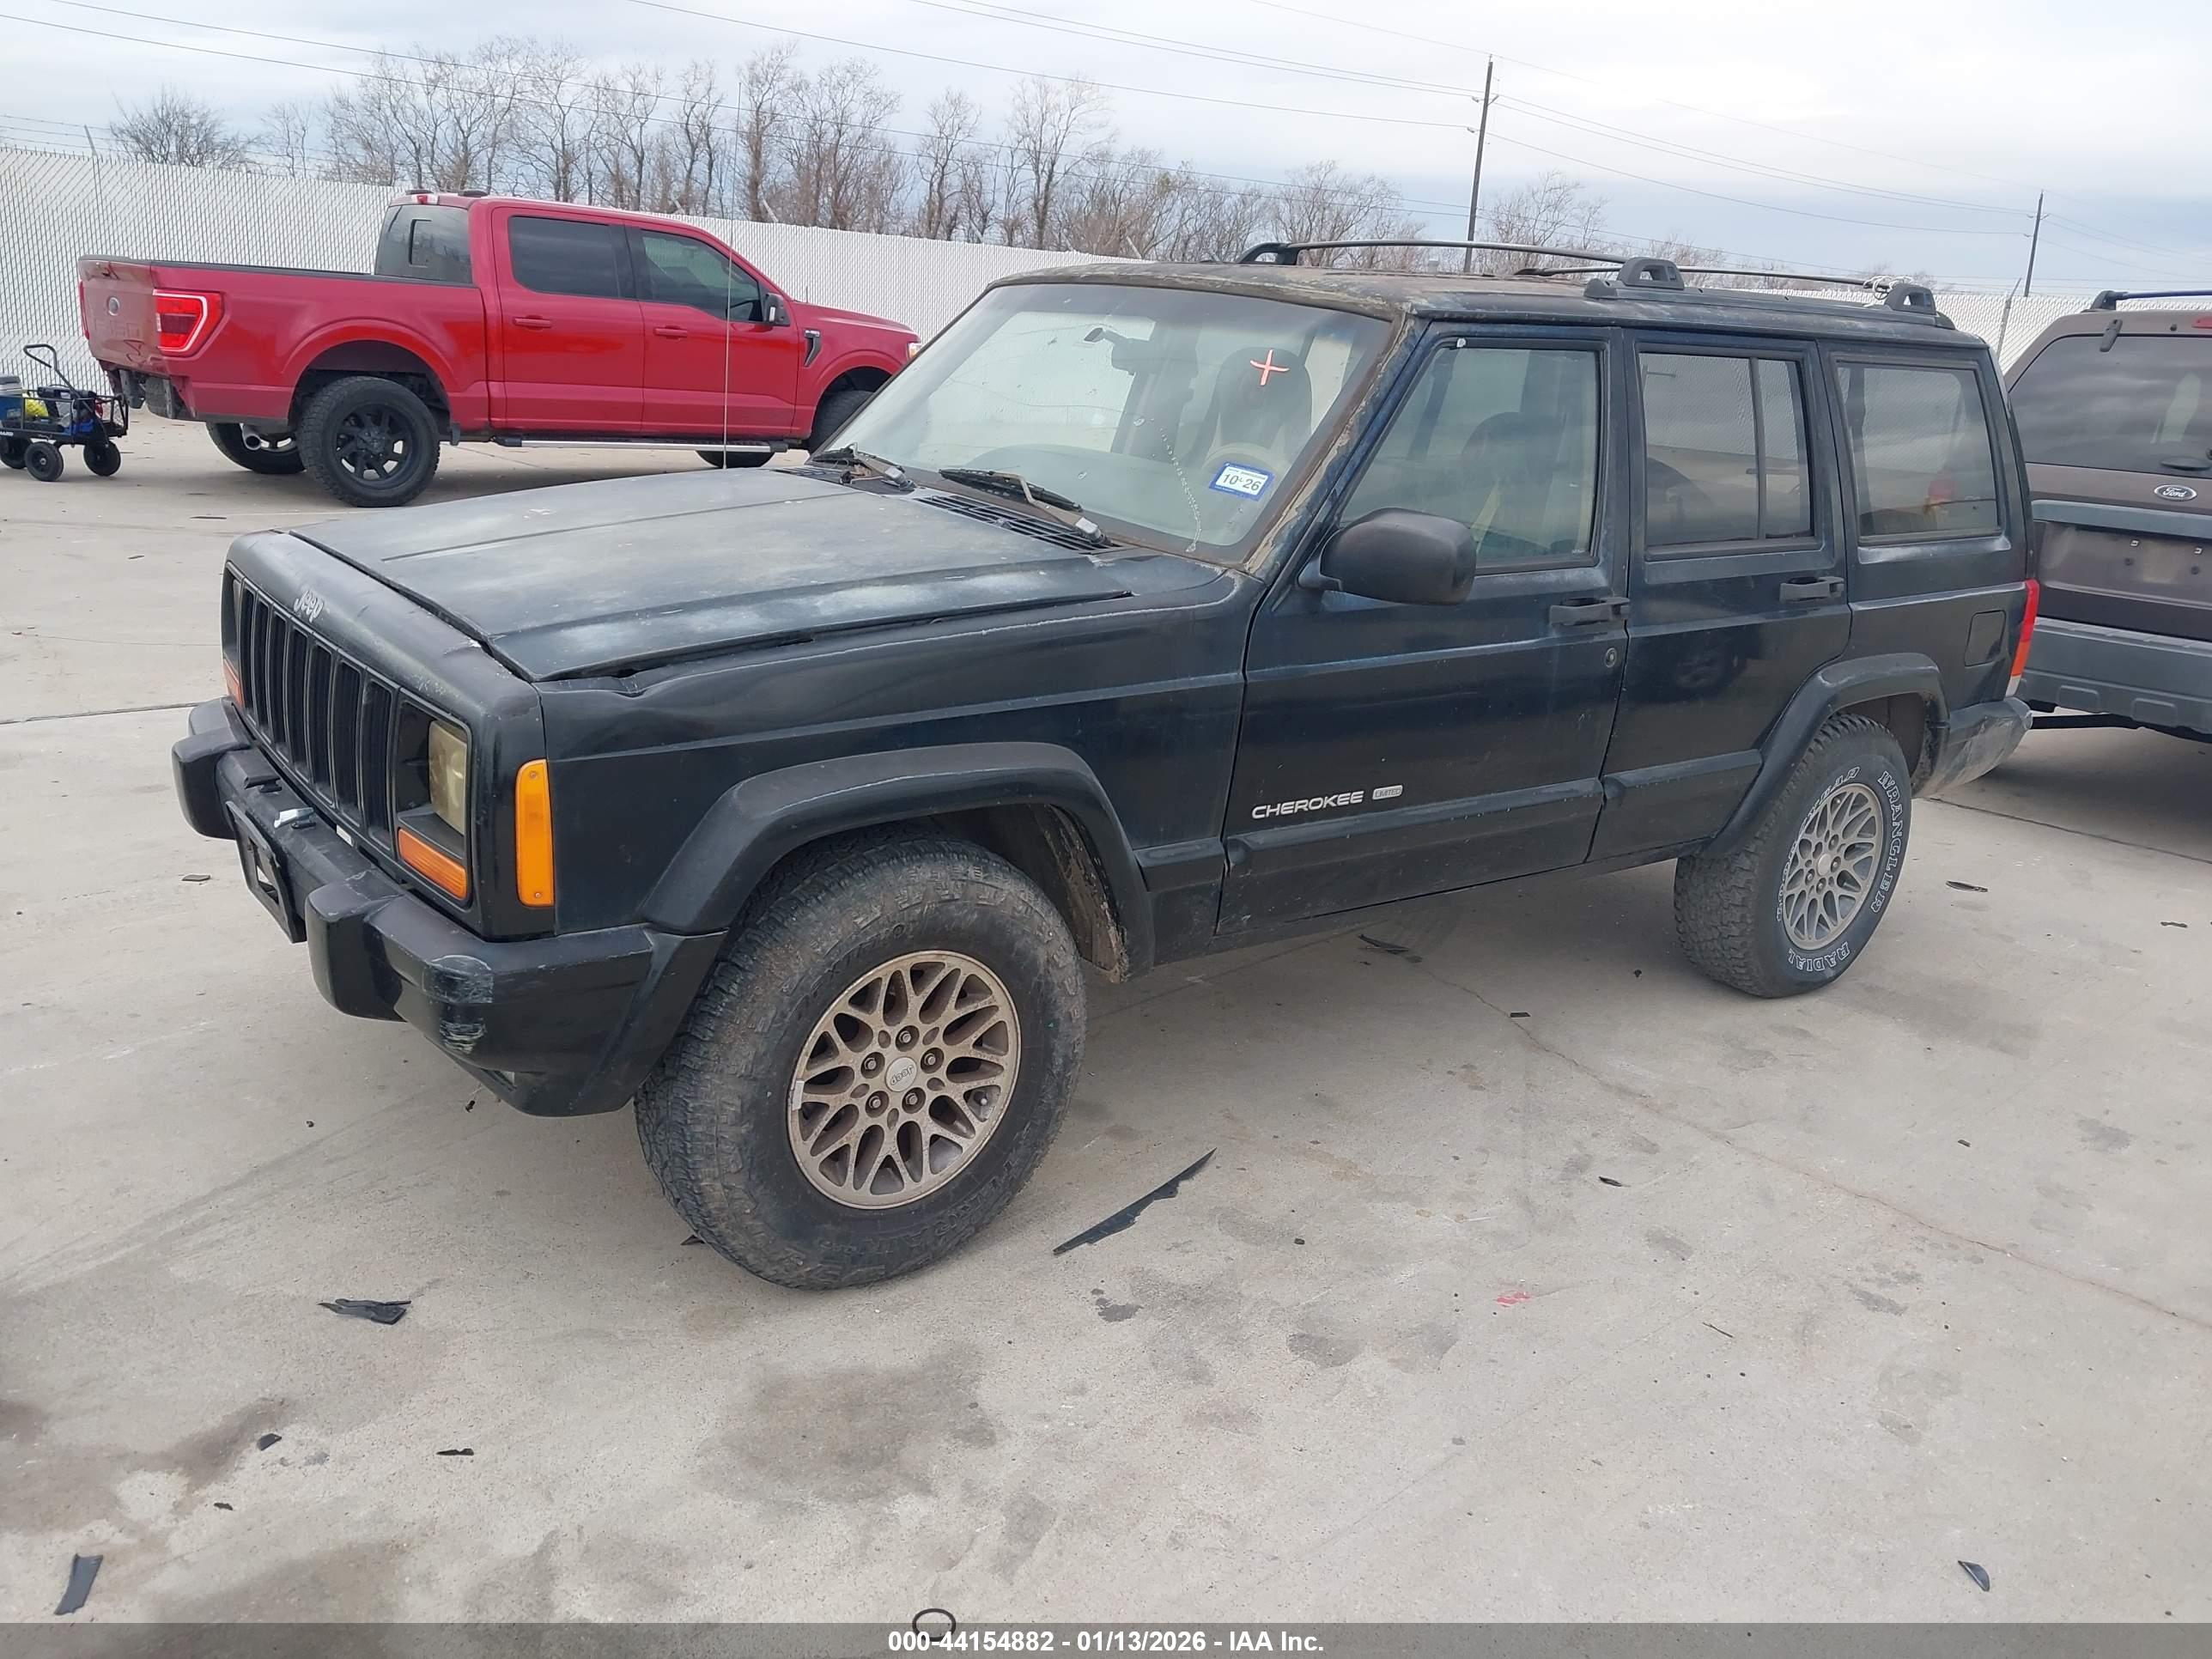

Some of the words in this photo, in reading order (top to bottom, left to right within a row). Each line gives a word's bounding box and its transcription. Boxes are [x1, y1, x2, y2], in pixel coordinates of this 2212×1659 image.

[1222, 473, 1238, 486] 10
[1242, 478, 1262, 491] 26
[293, 590, 324, 623] Jeep
[1251, 790, 1364, 819] CHEROKEE
[1375, 786, 1402, 799] LIMITED
[1870, 770, 1905, 914] WRANGLER
[1788, 942, 1850, 972] RADIAL
[890, 1065, 915, 1085] Jeep
